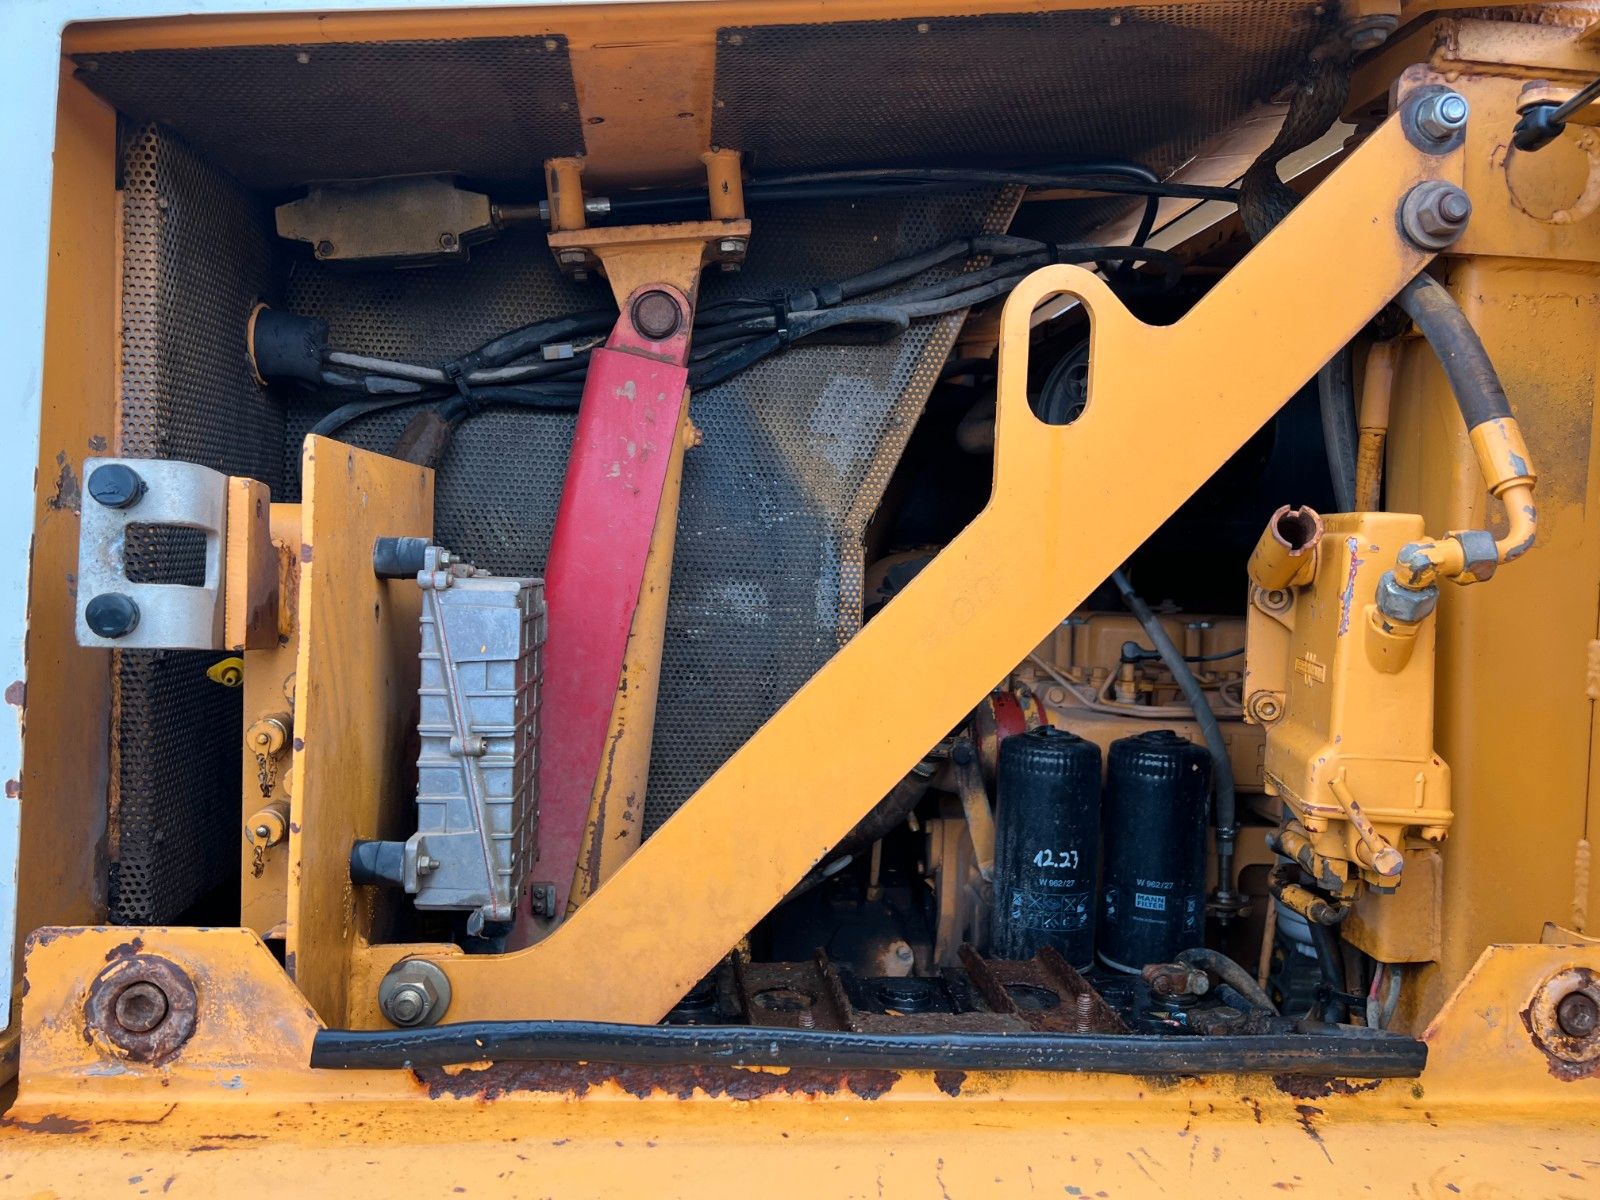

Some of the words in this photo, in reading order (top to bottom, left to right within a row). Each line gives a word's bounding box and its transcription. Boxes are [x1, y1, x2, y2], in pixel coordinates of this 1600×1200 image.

[1136, 878, 1145, 886] W
[1137, 894, 1164, 903] MANN
[1137, 900, 1164, 909] FILTER
